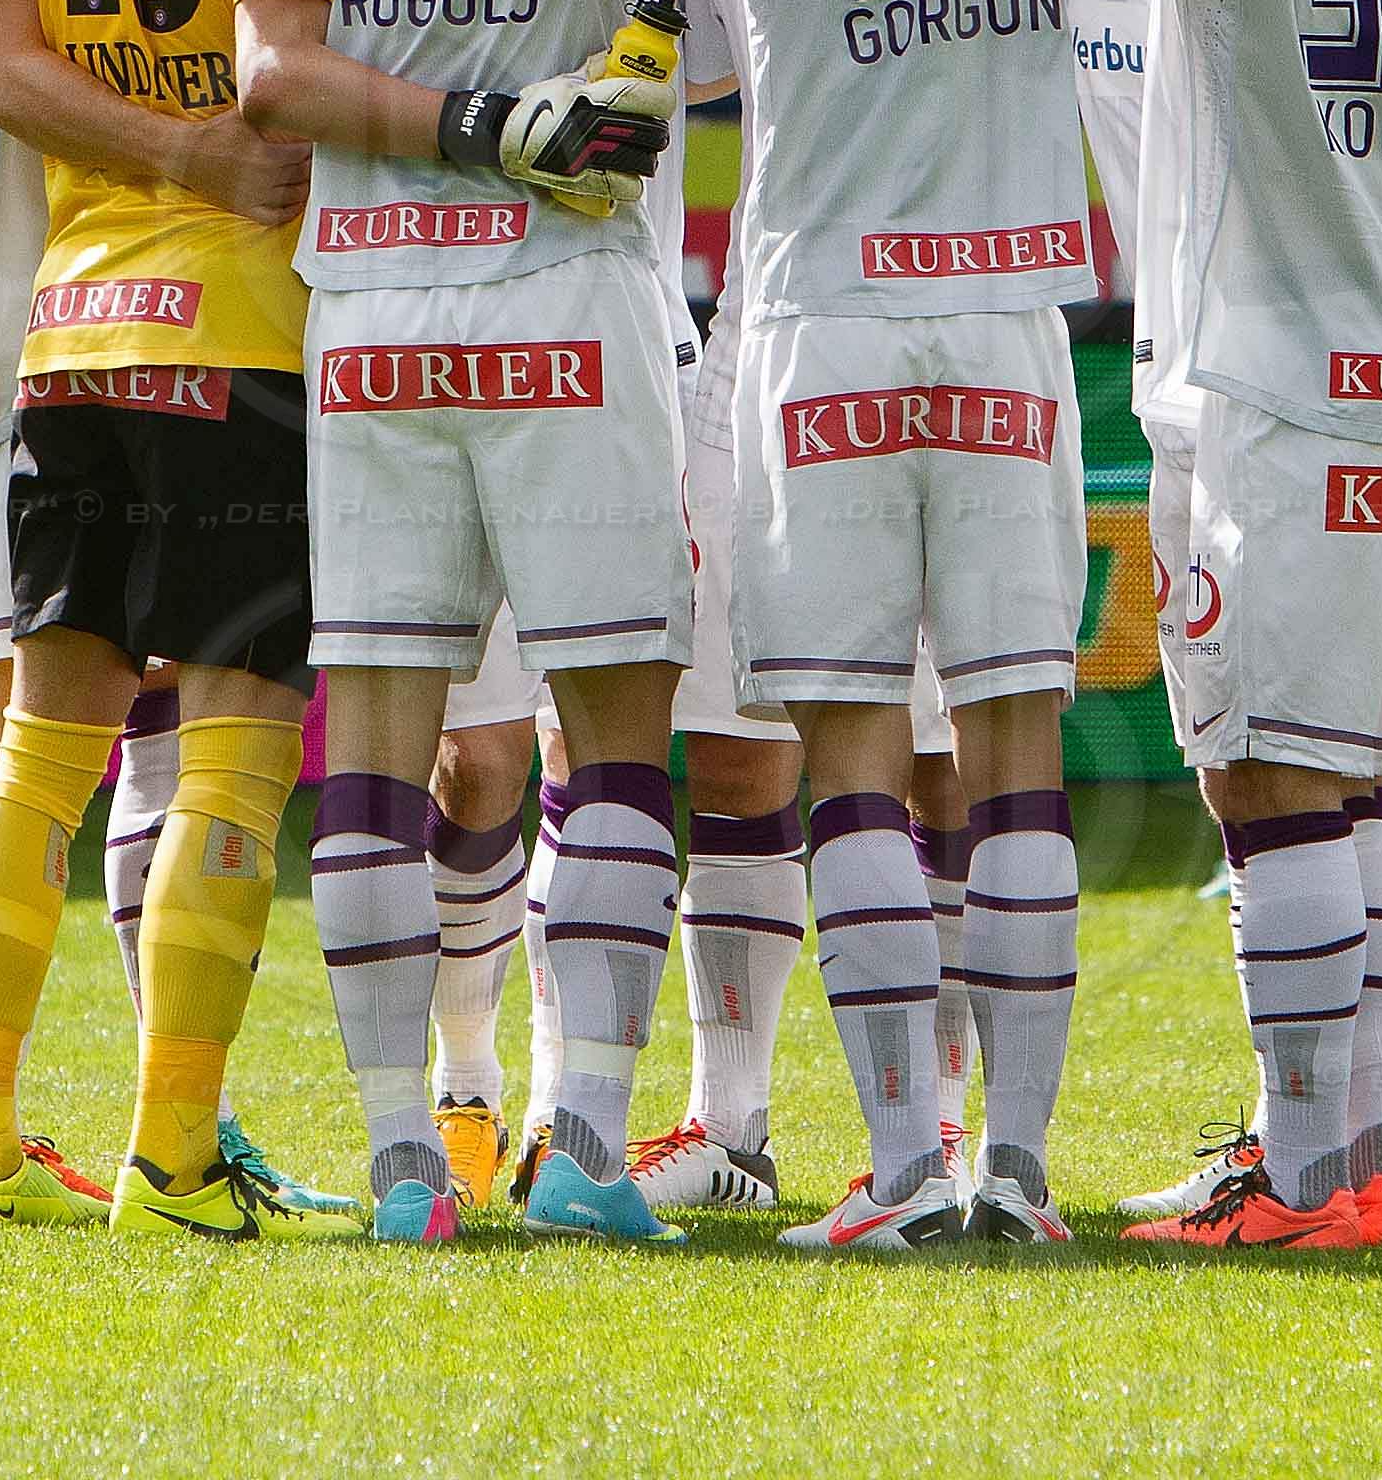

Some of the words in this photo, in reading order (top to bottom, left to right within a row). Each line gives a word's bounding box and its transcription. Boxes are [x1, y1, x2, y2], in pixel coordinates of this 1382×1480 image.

[325, 206, 518, 249] KURIER
[871, 228, 1077, 275] KURIER
[31, 283, 186, 329] KURIER
[322, 347, 597, 406] KURIER
[792, 390, 1057, 461] KURIER
